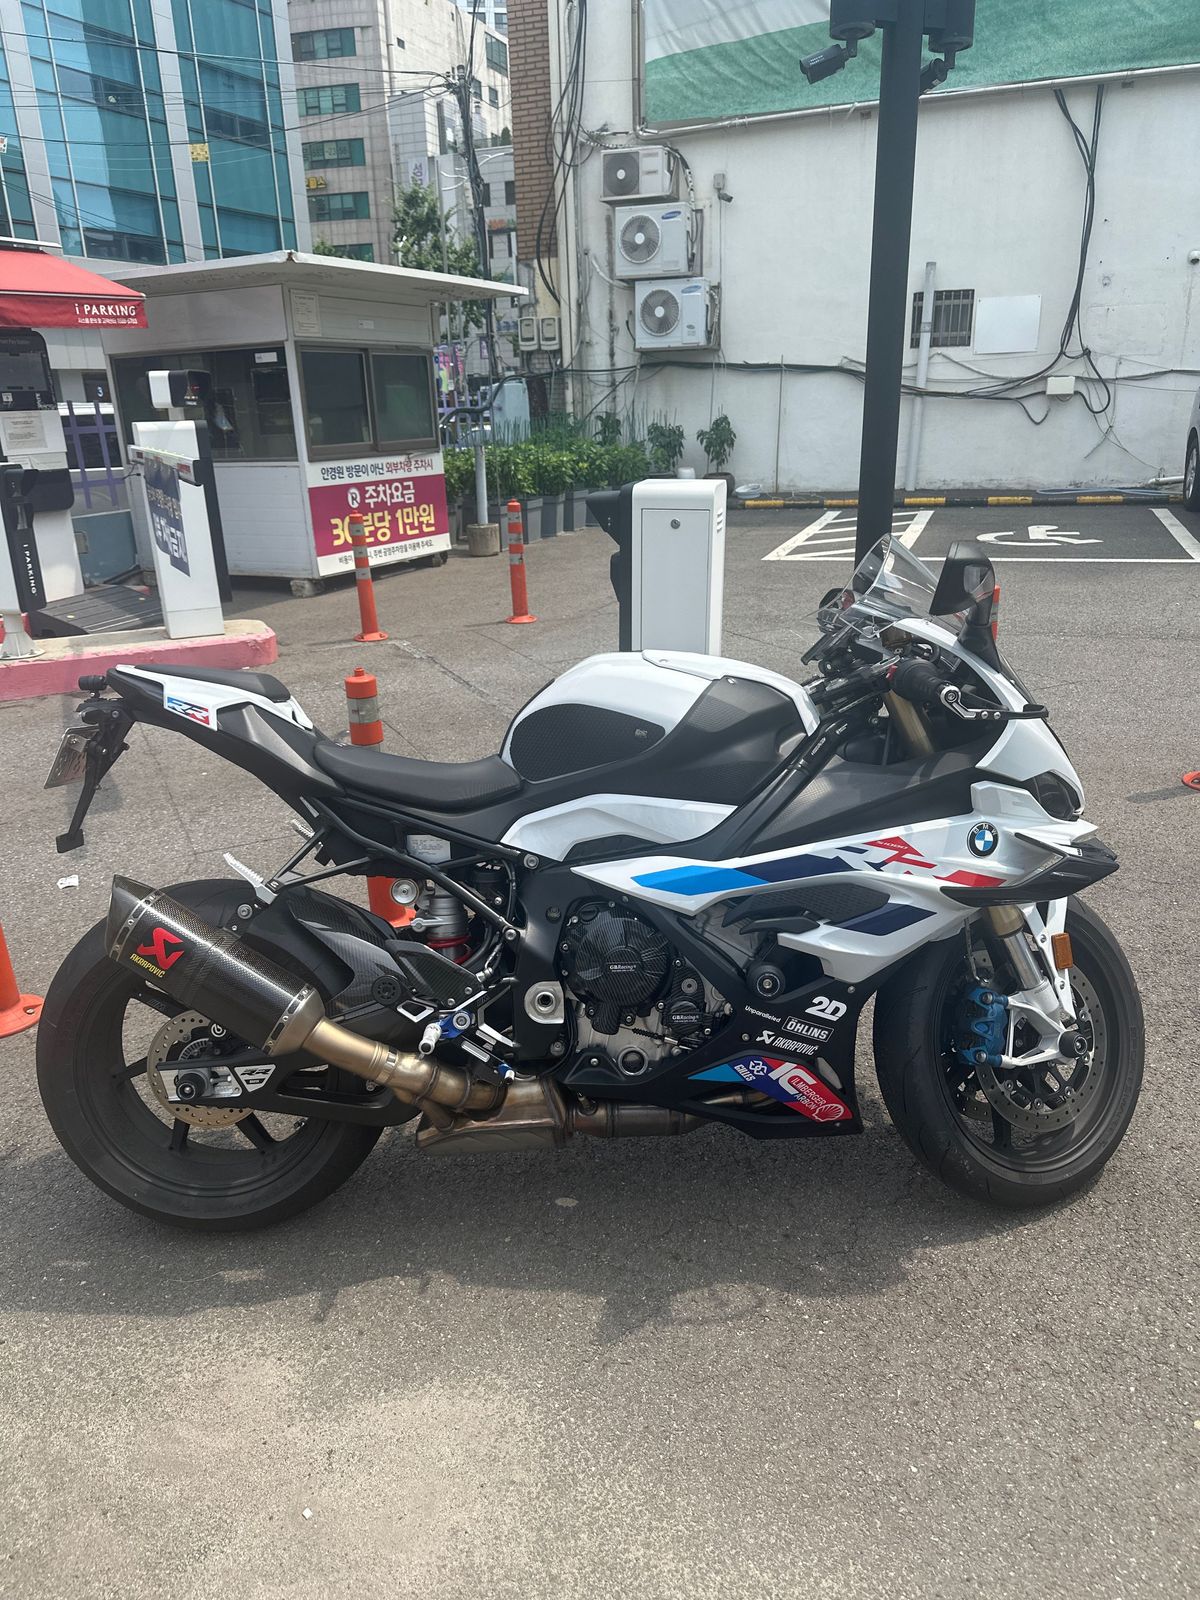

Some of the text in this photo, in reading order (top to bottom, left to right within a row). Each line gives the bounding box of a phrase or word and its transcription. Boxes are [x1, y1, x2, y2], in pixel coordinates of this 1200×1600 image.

[83, 304, 136, 316] PARKING
[320, 458, 434, 481] 안경원 방문이 아닌 외부차량 주차시
[364, 481, 415, 509] 주차요금
[395, 503, 436, 536] 1만원
[24, 551, 37, 594] PARKING
[744, 1005, 781, 1023] Unparalleled
[805, 996, 847, 1021] 2D
[786, 1018, 829, 1040] ÖHLINS
